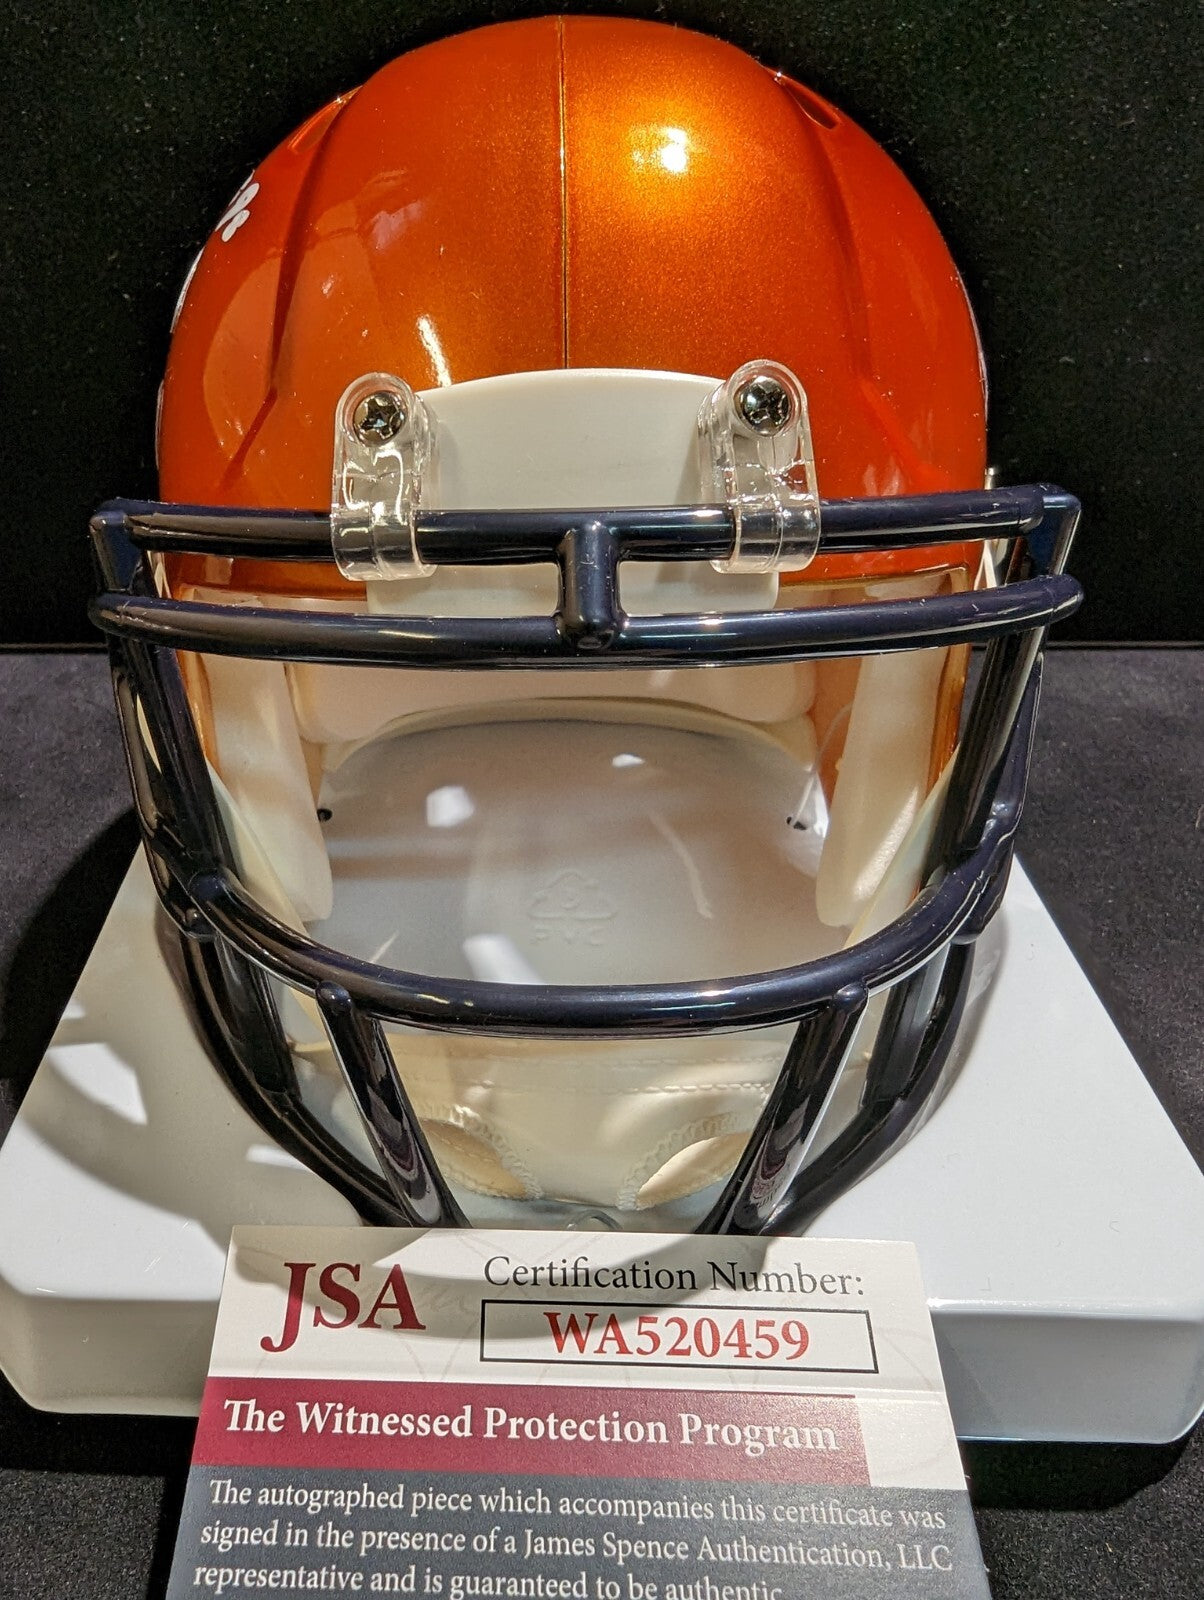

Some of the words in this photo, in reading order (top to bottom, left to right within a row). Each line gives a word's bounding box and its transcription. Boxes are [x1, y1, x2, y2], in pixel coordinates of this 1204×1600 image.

[484, 1255, 698, 1291] Certification
[707, 1260, 865, 1297] Number:
[260, 1262, 426, 1352] JSA
[543, 1311, 810, 1361] WA520459
[223, 1398, 285, 1432] The
[296, 1401, 473, 1437] Witnessed
[483, 1406, 668, 1444] Protection
[677, 1412, 841, 1457] Program
[210, 1479, 251, 1504] The
[257, 1483, 404, 1515] autographed
[411, 1487, 472, 1518] piece
[479, 1487, 552, 1514] which
[559, 1495, 714, 1524] accompanies
[721, 1495, 766, 1522] this
[773, 1499, 895, 1528] certificate
[901, 1509, 946, 1530] was
[200, 1519, 278, 1552] signed
[284, 1522, 309, 1547] in
[317, 1521, 354, 1548] the
[360, 1529, 466, 1556] presence
[472, 1526, 501, 1552] of
[504, 1536, 517, 1554] a
[523, 1529, 595, 1560] James
[603, 1532, 689, 1565] Spence
[697, 1535, 892, 1571] Authentication,
[898, 1544, 953, 1571] LLC
[193, 1564, 364, 1595] representative
[370, 1564, 416, 1593] and
[424, 1568, 443, 1593] is
[449, 1571, 588, 1600] guaranteed
[596, 1576, 621, 1598] to
[627, 1573, 658, 1600] be
